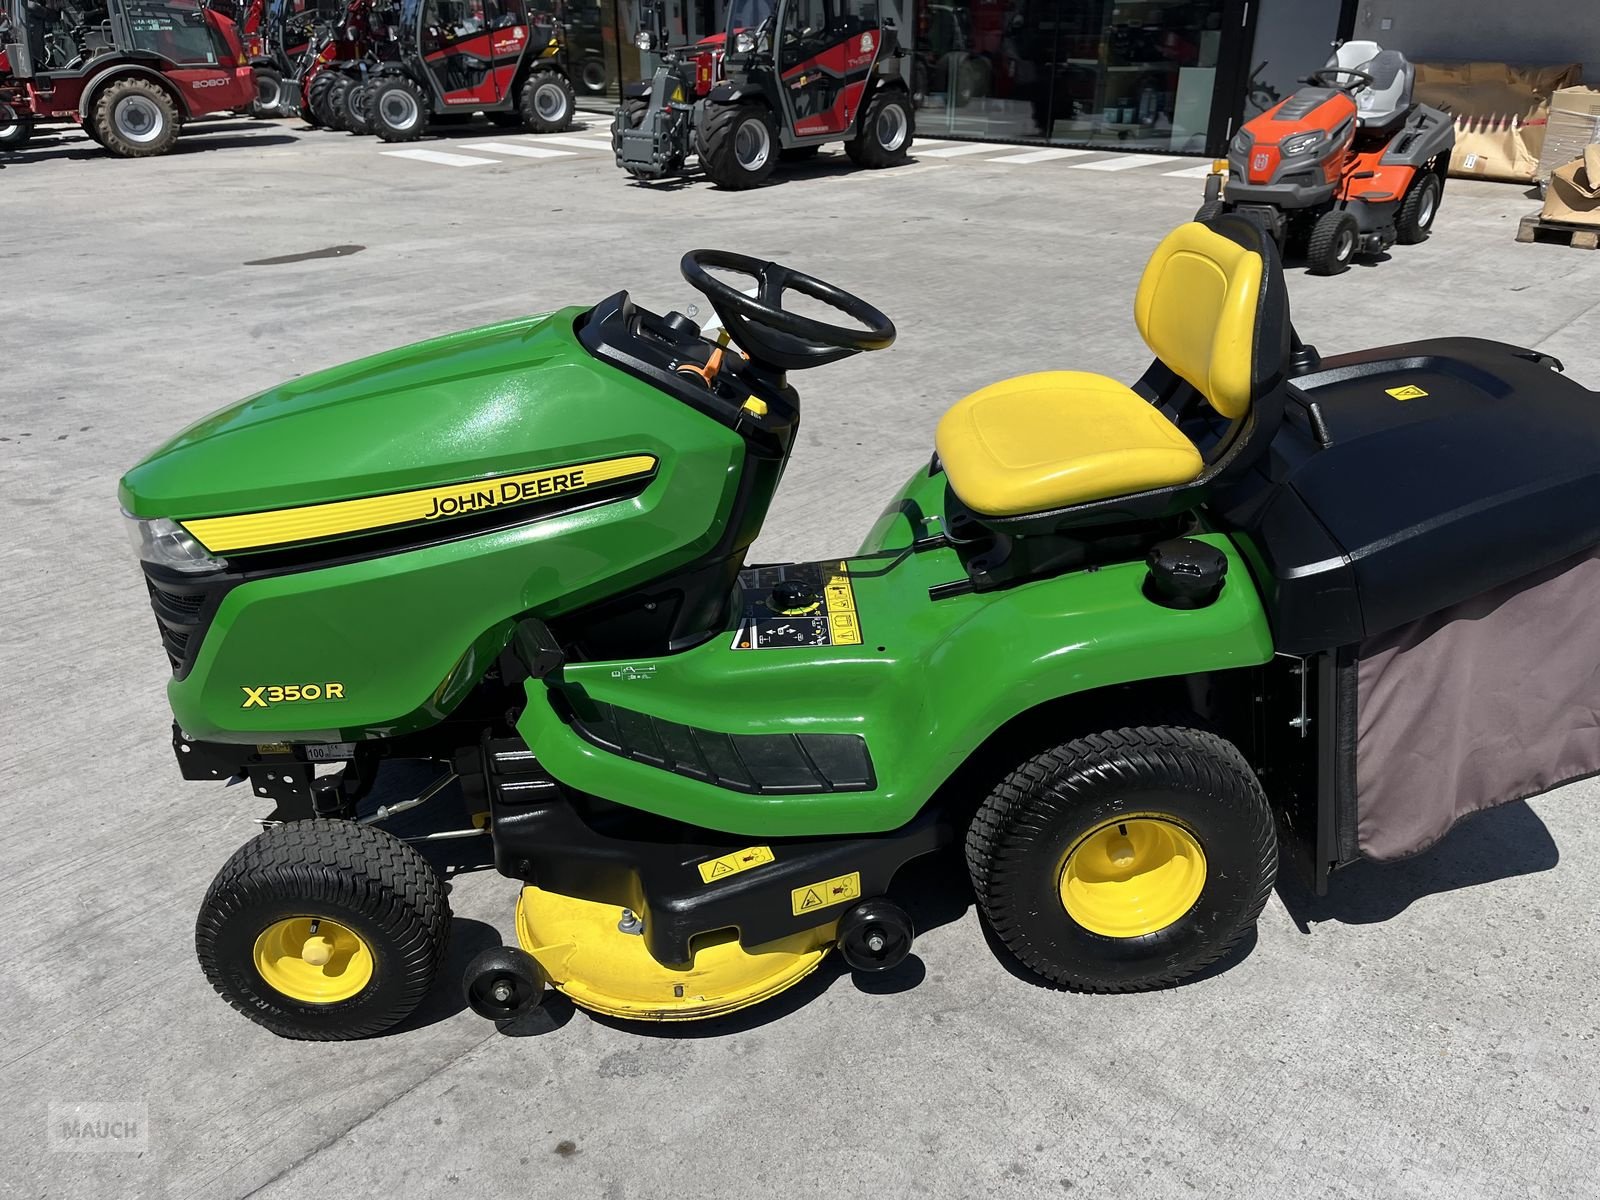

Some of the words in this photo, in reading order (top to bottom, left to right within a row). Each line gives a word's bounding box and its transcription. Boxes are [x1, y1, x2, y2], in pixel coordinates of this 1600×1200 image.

[425, 489, 495, 517] JOHN
[501, 470, 585, 502] DEERE
[241, 683, 322, 708] X350
[325, 682, 346, 700] R
[308, 748, 324, 758] 100
